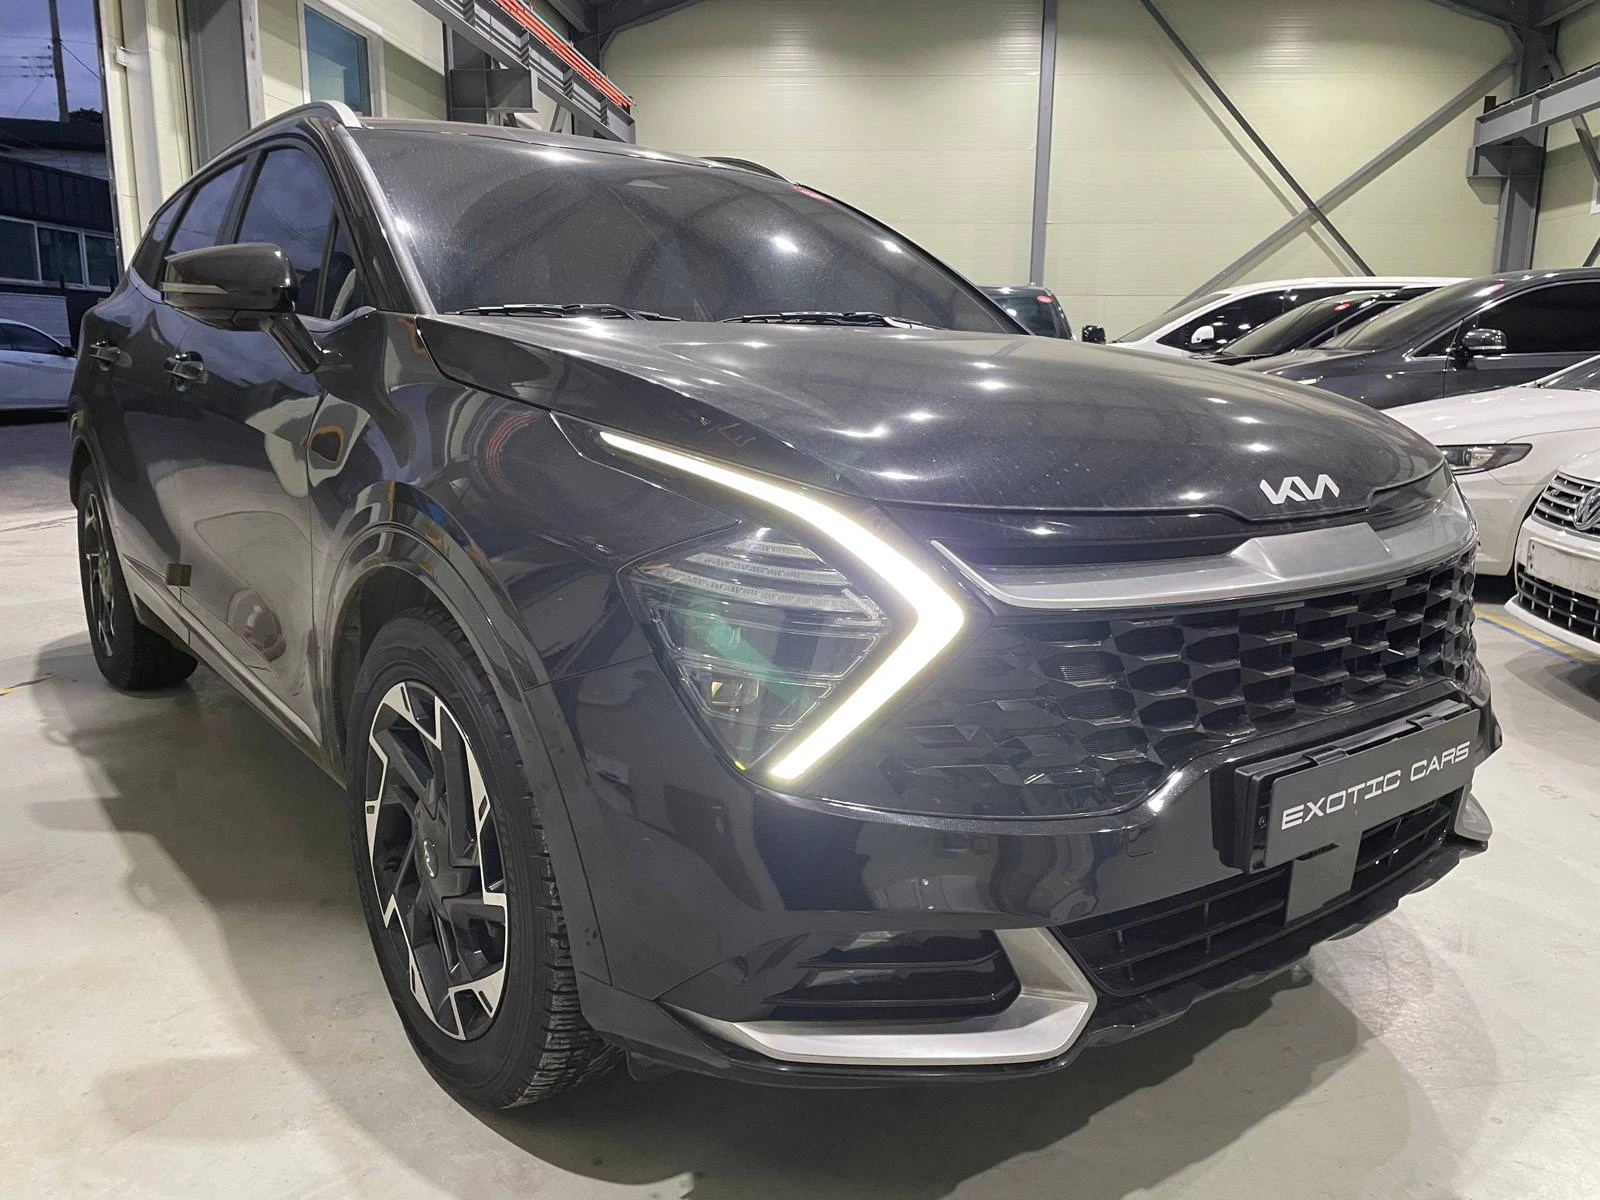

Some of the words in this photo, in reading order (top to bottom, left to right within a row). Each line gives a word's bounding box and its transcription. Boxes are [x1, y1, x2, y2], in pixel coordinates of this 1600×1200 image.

[1259, 473, 1340, 505] KIA
[1281, 770, 1401, 830] EXOTIC
[1409, 741, 1471, 782] CARS
